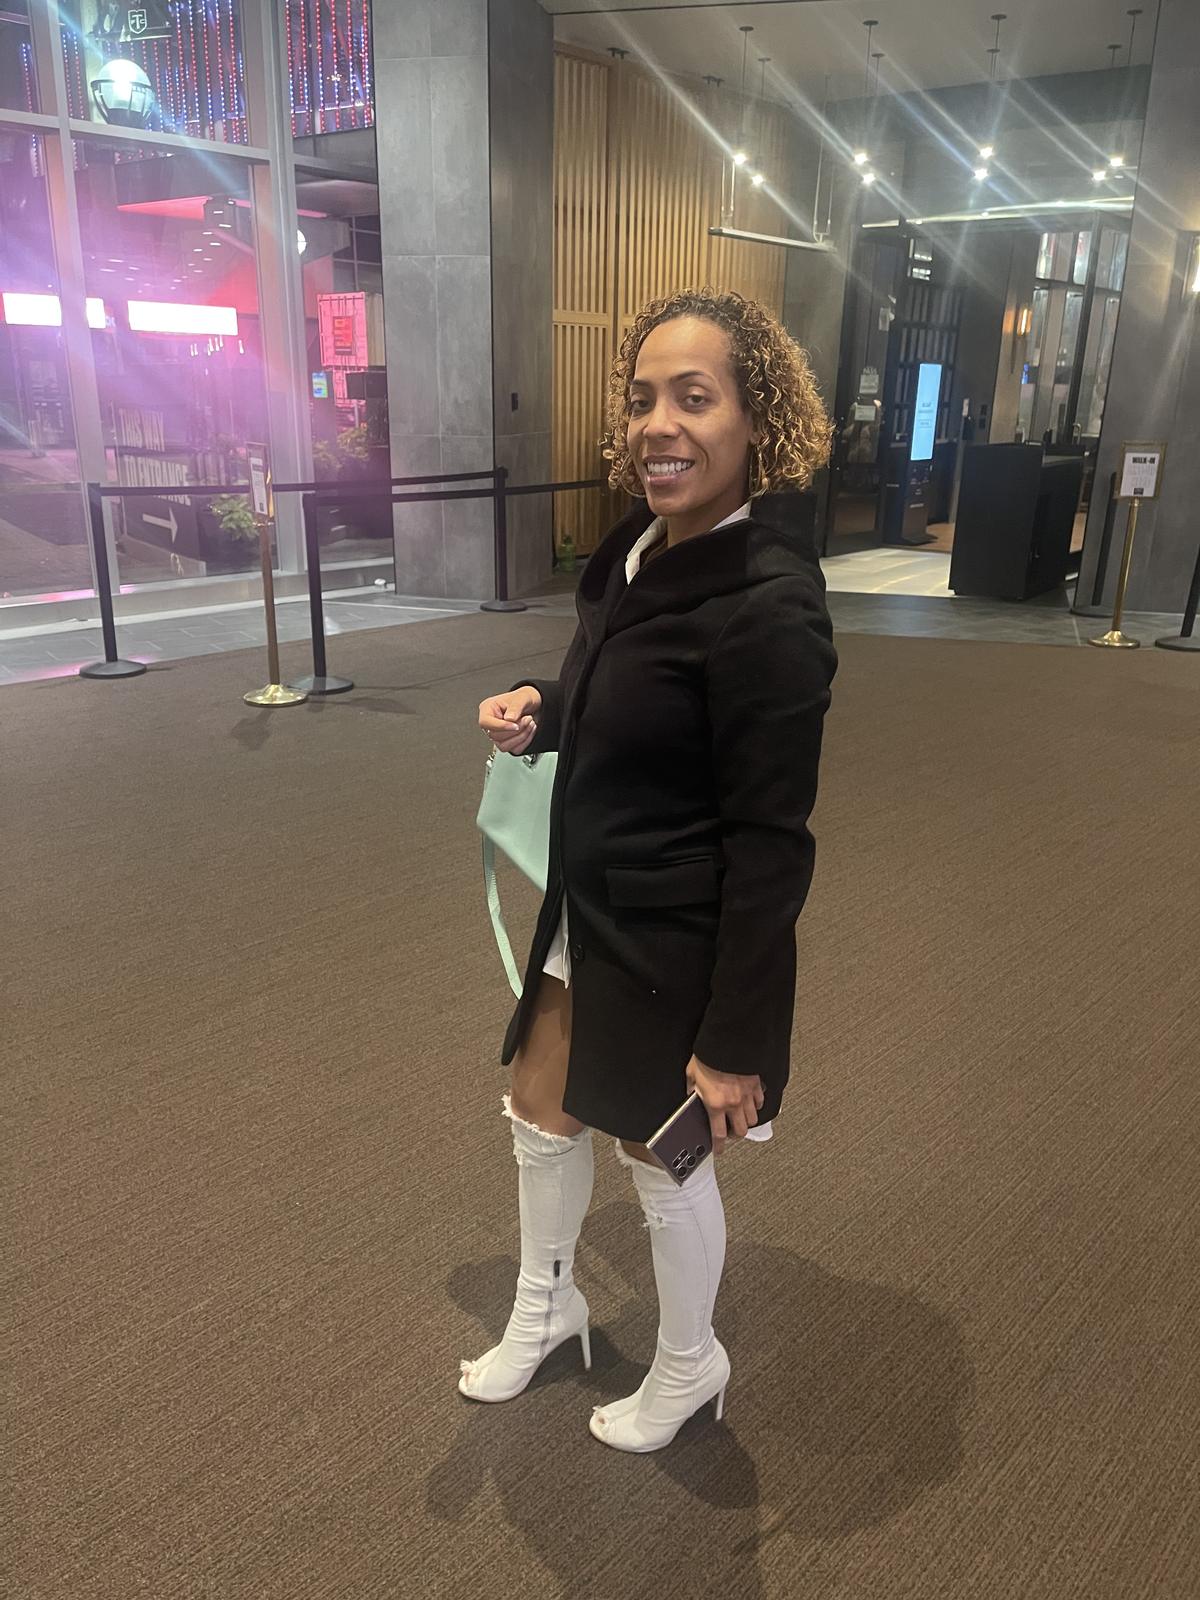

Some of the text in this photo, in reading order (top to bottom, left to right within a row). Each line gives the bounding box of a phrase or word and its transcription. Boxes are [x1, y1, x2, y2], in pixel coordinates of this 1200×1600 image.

[119, 408, 165, 452] THIS WAY
[124, 455, 191, 506] TO ENTRANCE
